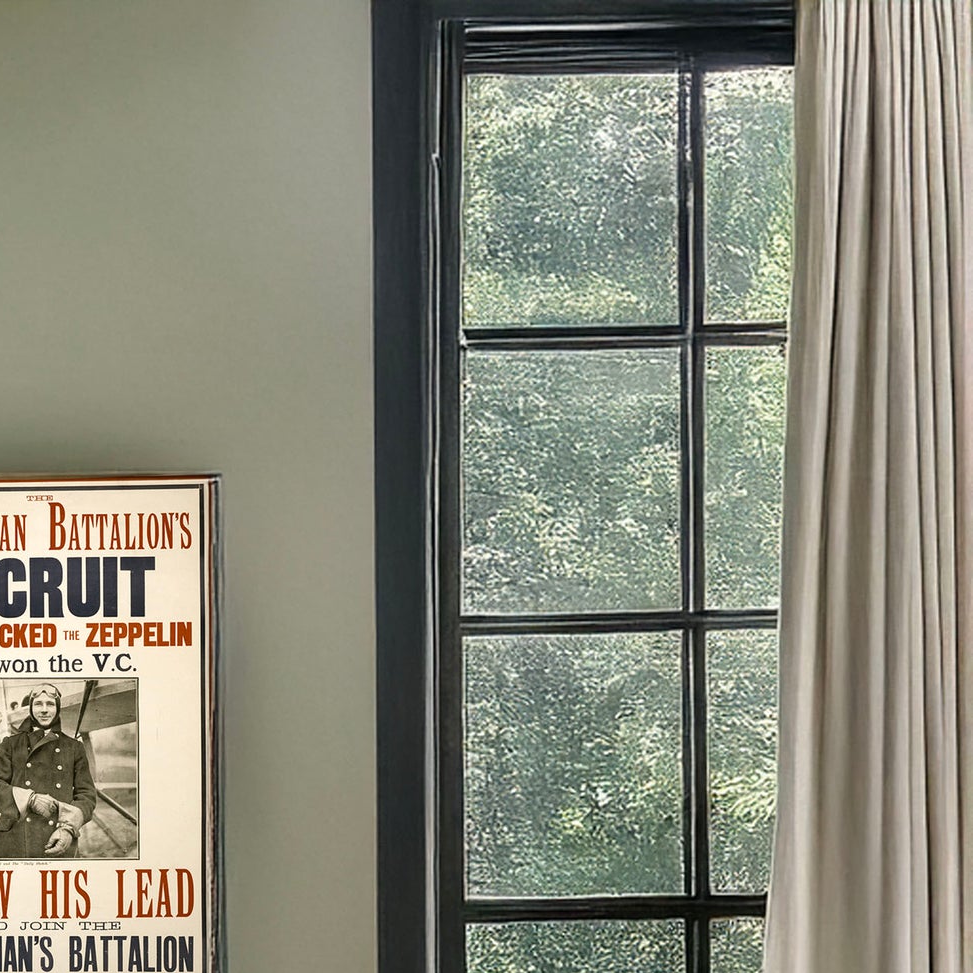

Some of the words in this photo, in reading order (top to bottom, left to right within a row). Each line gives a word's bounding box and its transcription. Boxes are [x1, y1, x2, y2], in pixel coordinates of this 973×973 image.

[25, 494, 54, 502] THE
[48, 502, 192, 550] BATTALION'S
[63, 630, 79, 640] THE
[86, 622, 192, 647] ZEPPELIN
[48, 654, 82, 672] the
[92, 654, 136, 672] V.C.
[39, 870, 91, 919] HIS
[116, 869, 194, 918] LEAD
[19, 921, 68, 931] JOIN
[78, 921, 122, 931] THE
[69, 936, 194, 972] BATTALION
